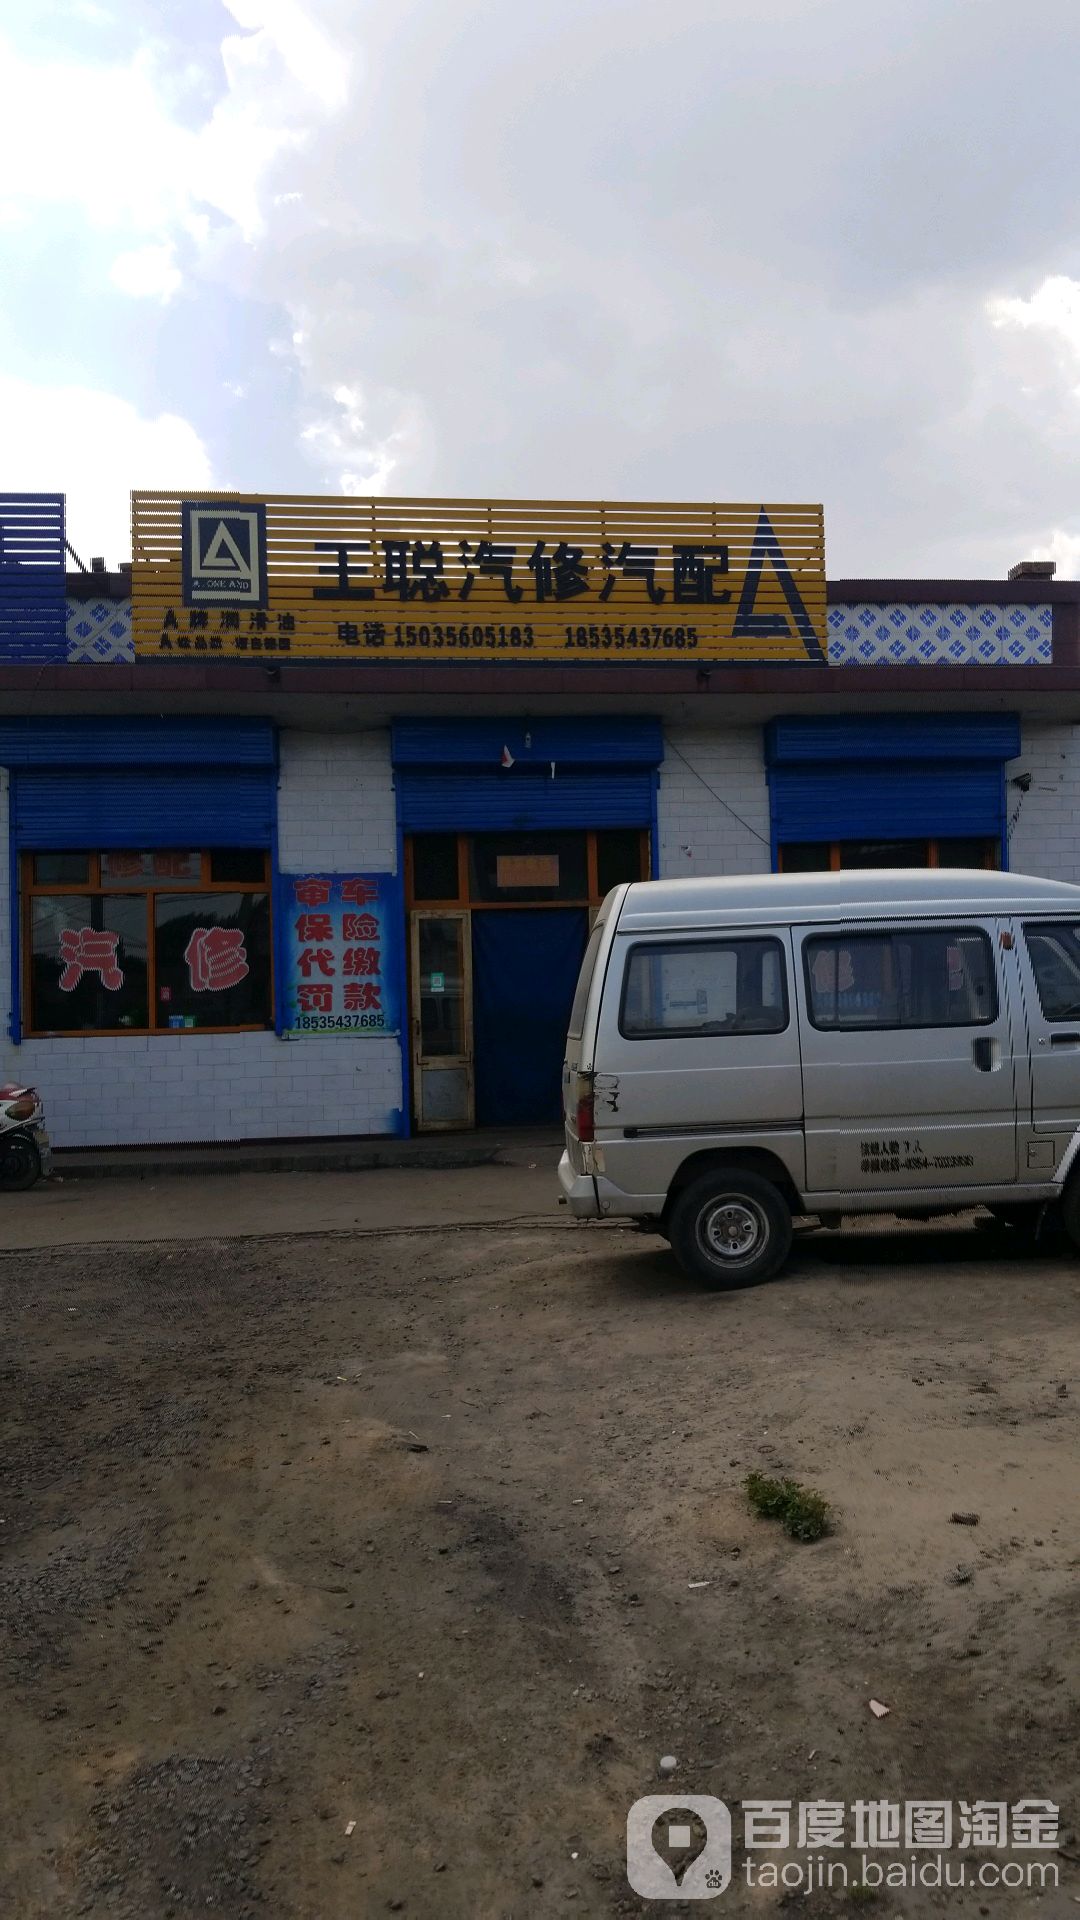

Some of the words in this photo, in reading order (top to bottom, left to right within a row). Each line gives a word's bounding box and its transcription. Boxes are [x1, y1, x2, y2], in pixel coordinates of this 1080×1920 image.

[313, 540, 731, 604] 王聪汽修汽配
[338, 622, 387, 646] 电话
[394, 625, 535, 648] 15035605183
[564, 626, 699, 649] 18535437685
[293, 878, 380, 907] 审车
[295, 912, 381, 943] 保险
[297, 947, 381, 978] 代缴
[297, 982, 382, 1013] 罚款
[295, 1013, 385, 1029] 18535437685
